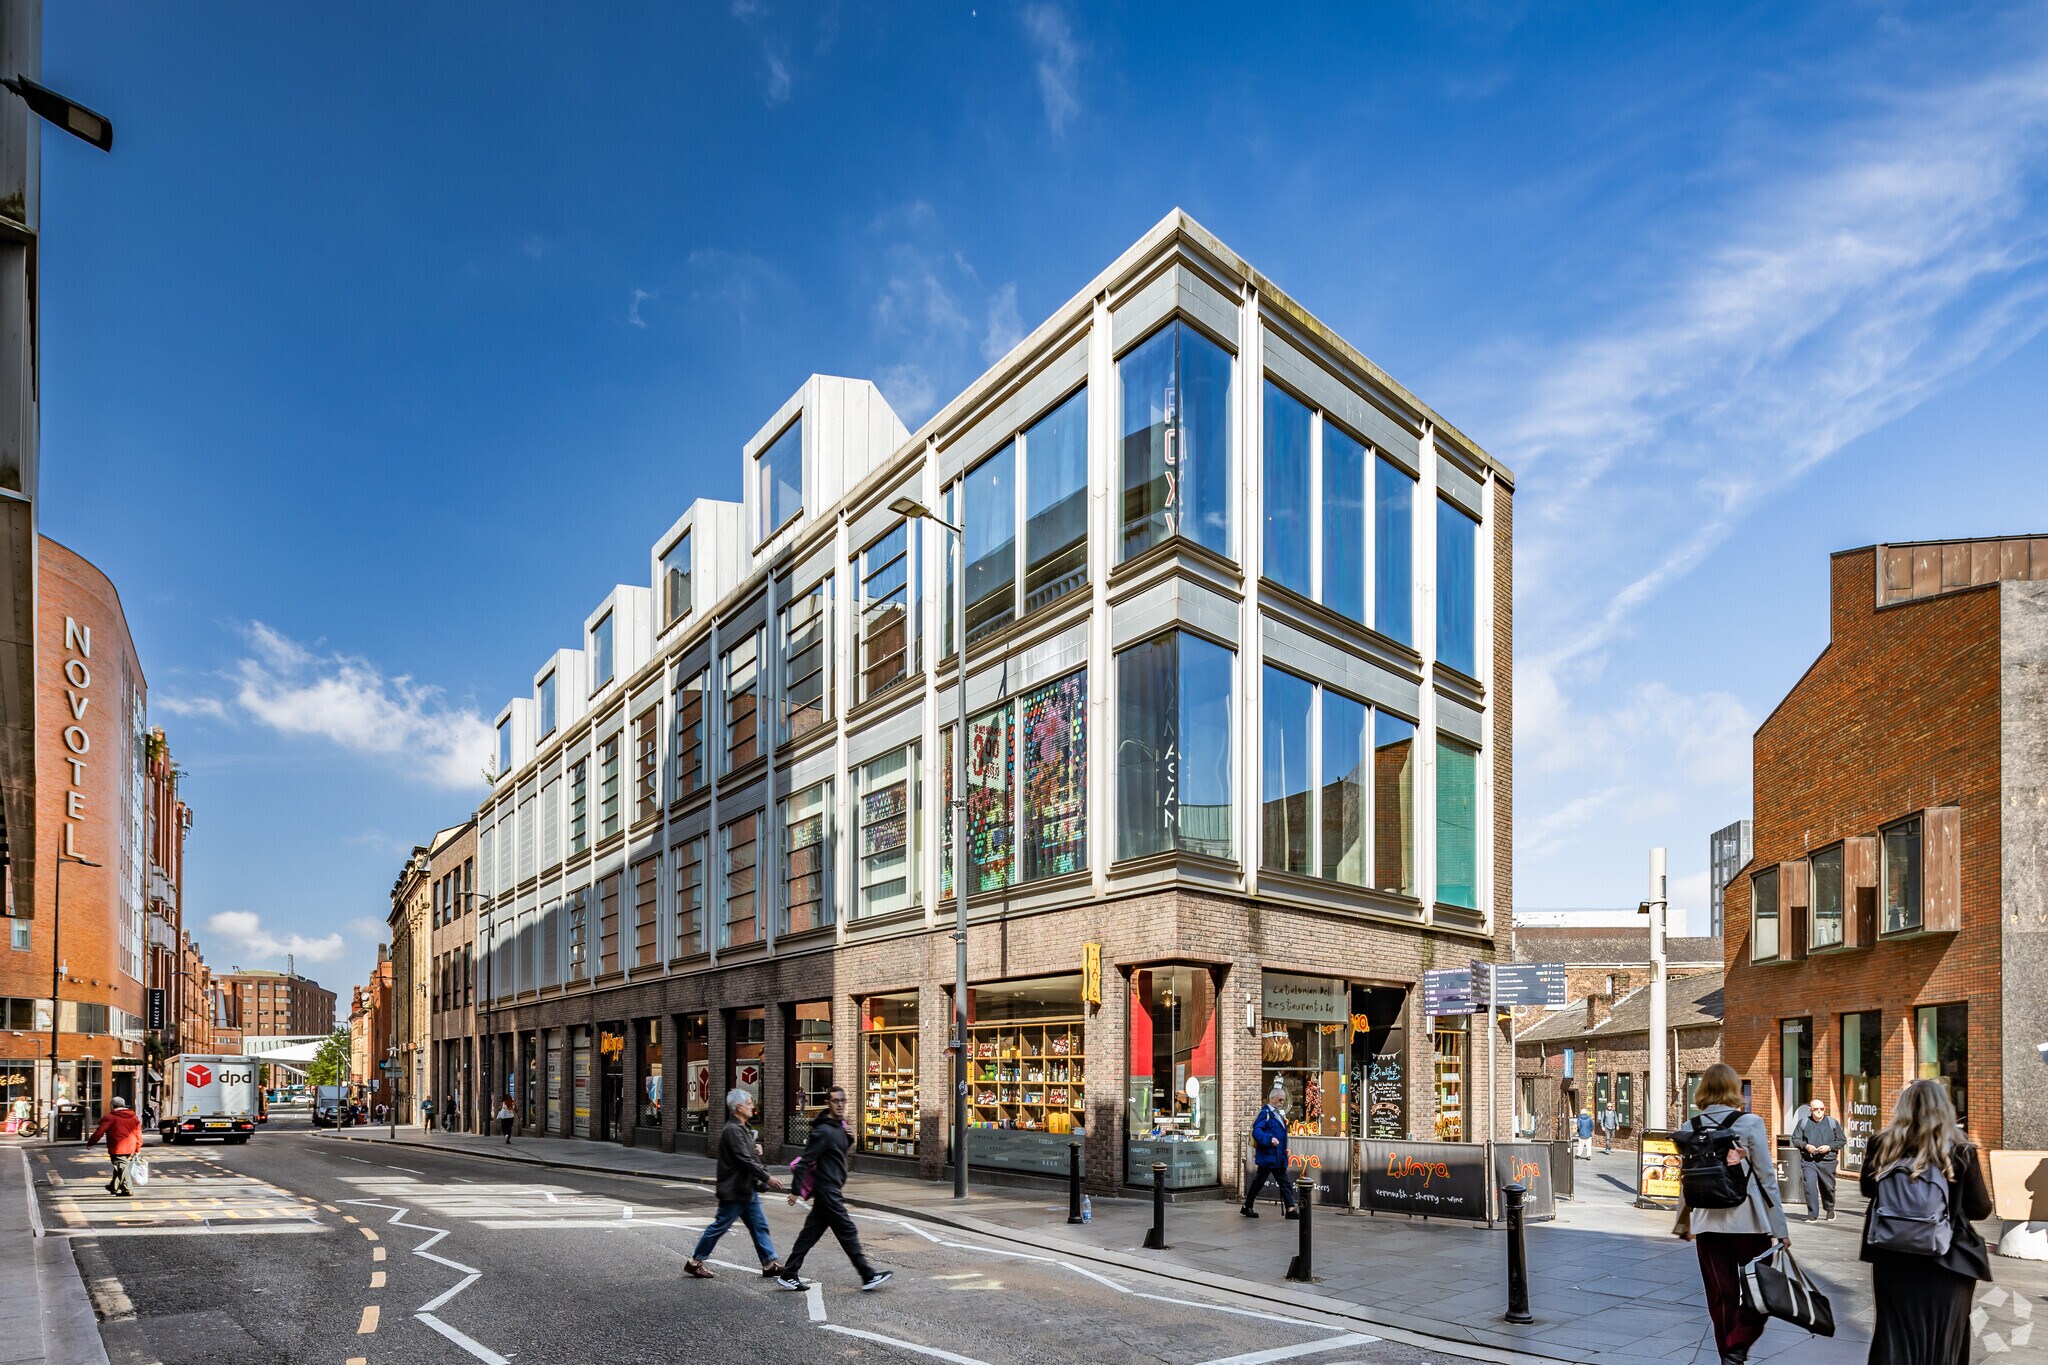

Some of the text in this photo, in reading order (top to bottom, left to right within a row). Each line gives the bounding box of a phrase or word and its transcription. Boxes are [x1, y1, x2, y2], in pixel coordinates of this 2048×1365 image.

[64, 616, 91, 859] NOVOTEL
[219, 1070, 251, 1086] dpd
[1847, 1101, 1877, 1116] A home
[1847, 1117, 1874, 1135] for art,
[1847, 1135, 1868, 1149] artist
[1286, 1149, 1322, 1178] nya
[1847, 1152, 1862, 1165] and
[1415, 1191, 1439, 1205] sherry
[1446, 1196, 1464, 1204] wine
